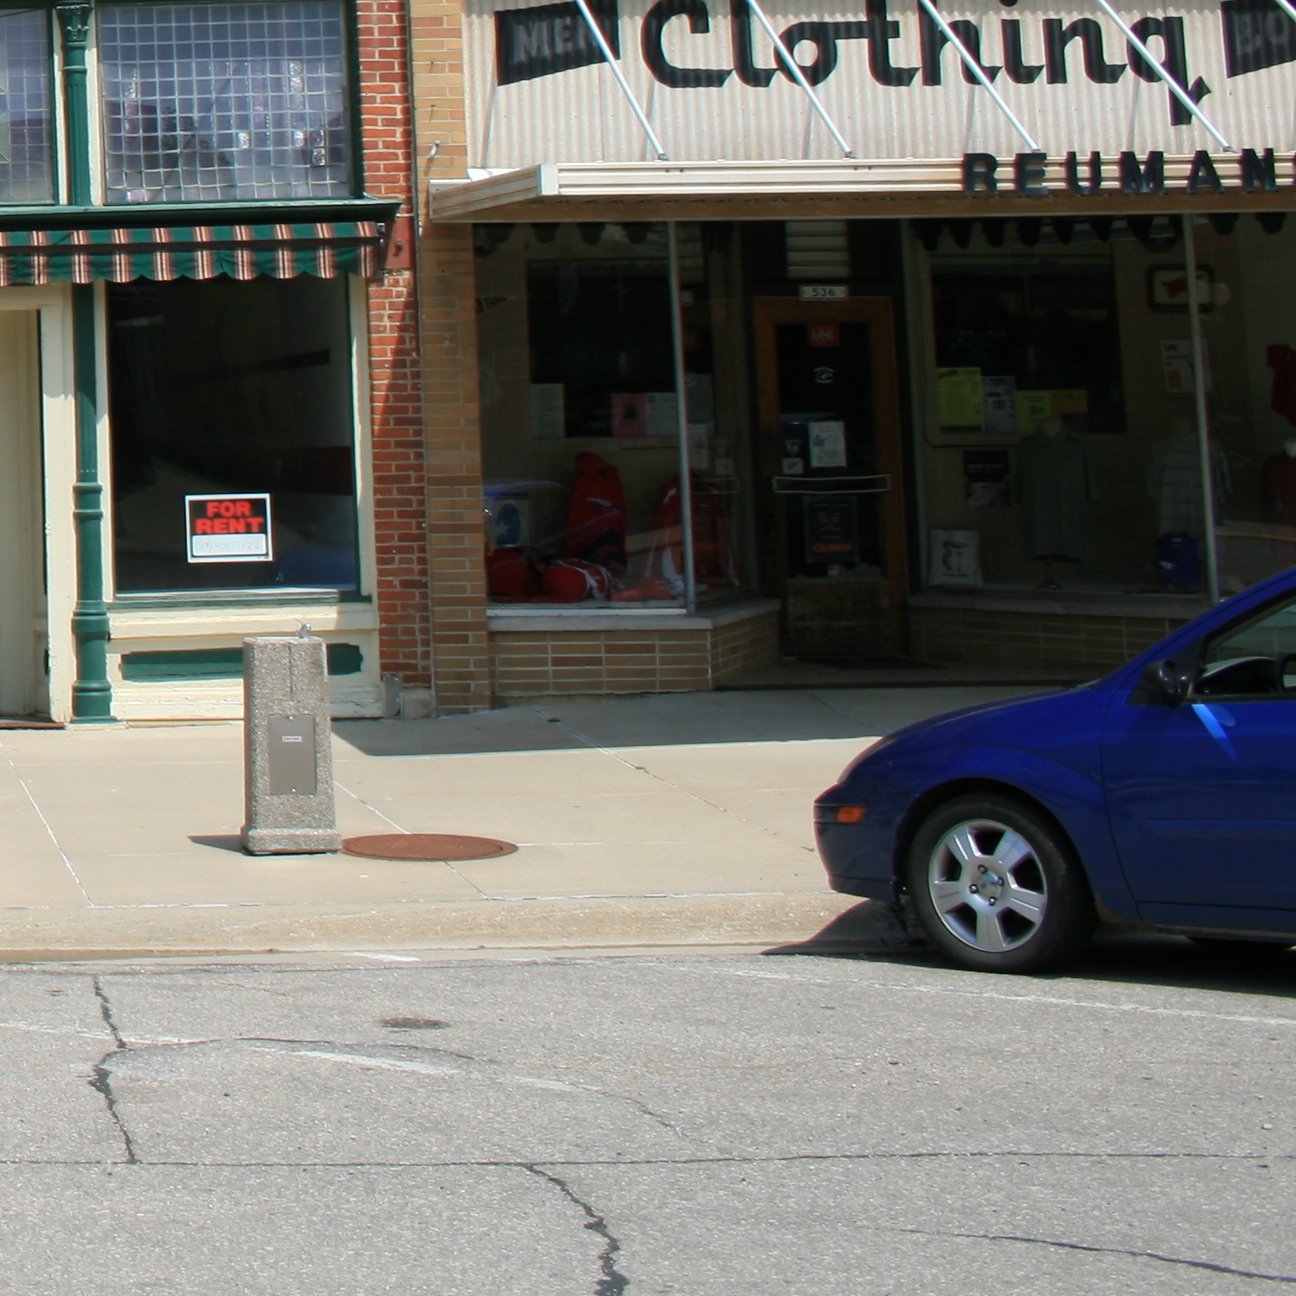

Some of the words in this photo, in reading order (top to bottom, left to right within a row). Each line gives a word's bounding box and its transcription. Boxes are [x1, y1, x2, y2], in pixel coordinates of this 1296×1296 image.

[811, 287, 835, 297] 536
[206, 500, 251, 517] FOR
[194, 517, 265, 534] RENT
